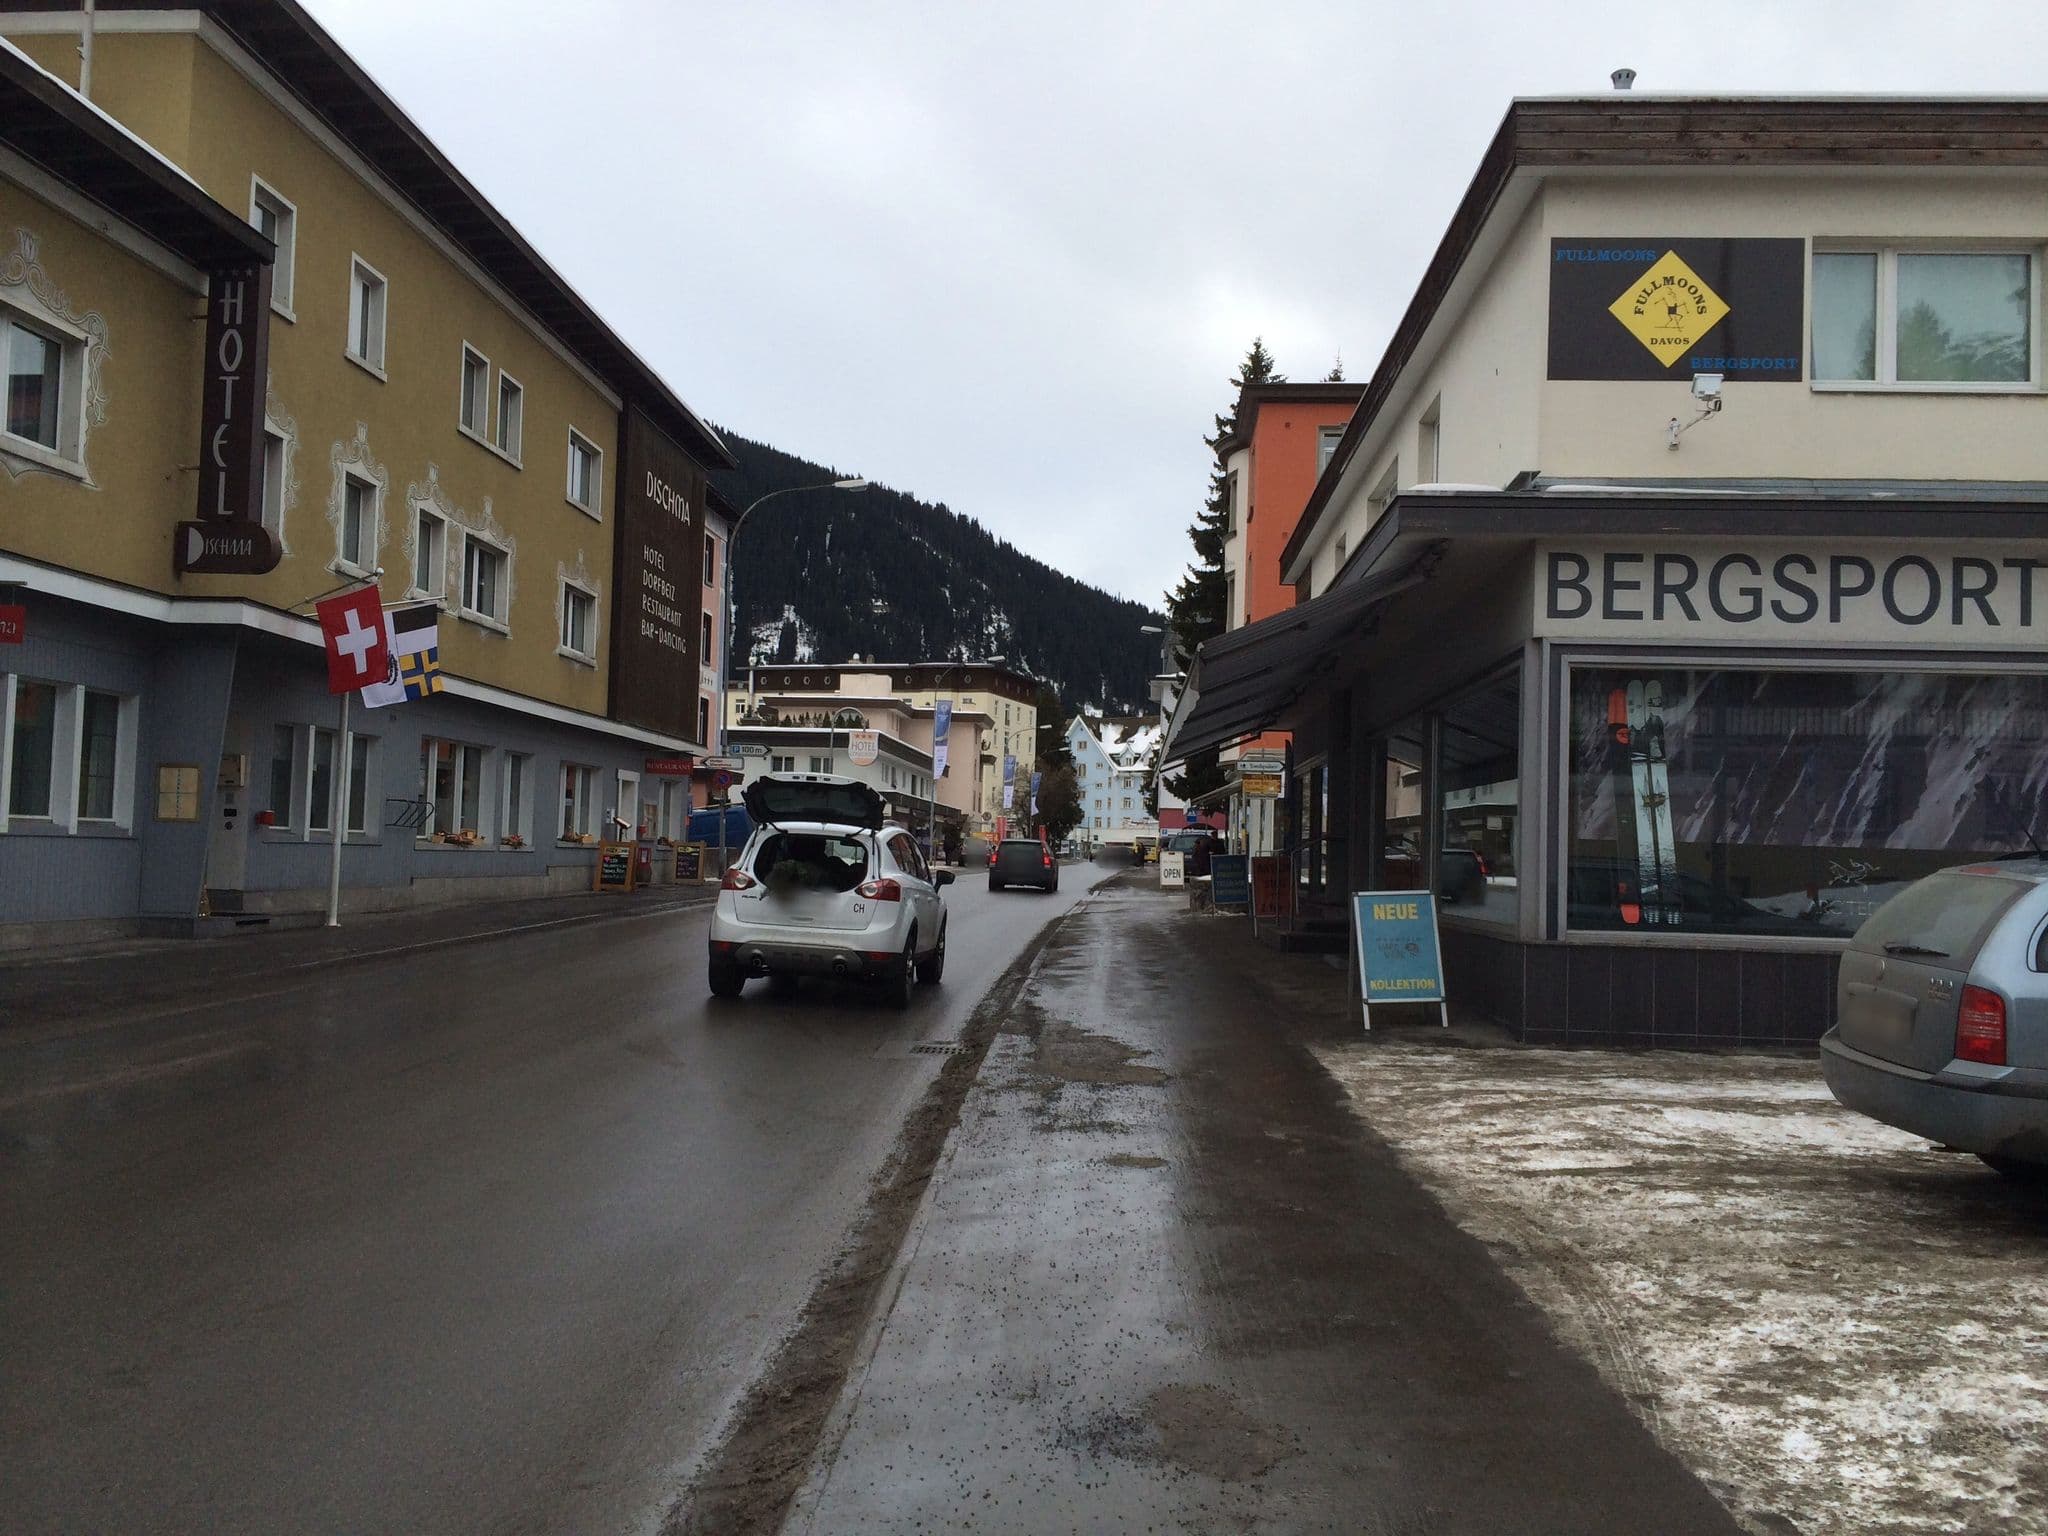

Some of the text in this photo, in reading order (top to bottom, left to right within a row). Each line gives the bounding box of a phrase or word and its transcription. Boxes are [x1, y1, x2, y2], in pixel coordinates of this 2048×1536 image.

[1555, 248, 1657, 262] FULLMOONS
[1633, 275, 1707, 316] FULLMOONS
[1650, 337, 1690, 345] DAVOS
[1690, 357, 1799, 369] BERGSPORT
[212, 280, 244, 515] HOTEL
[646, 471, 690, 526] DISCHMA
[643, 544, 666, 572] HOTEL
[642, 569, 676, 602] DORFBEIZ
[1546, 551, 2048, 627] BERGSPORT
[642, 594, 682, 628] RESTAURANT
[742, 745, 755, 754] 100
[851, 741, 877, 752] HOTEL
[1163, 868, 1181, 879] OPEN
[853, 903, 865, 914] CH
[1373, 903, 1418, 920] NEUE
[1370, 979, 1436, 991] KOLLEKTION
